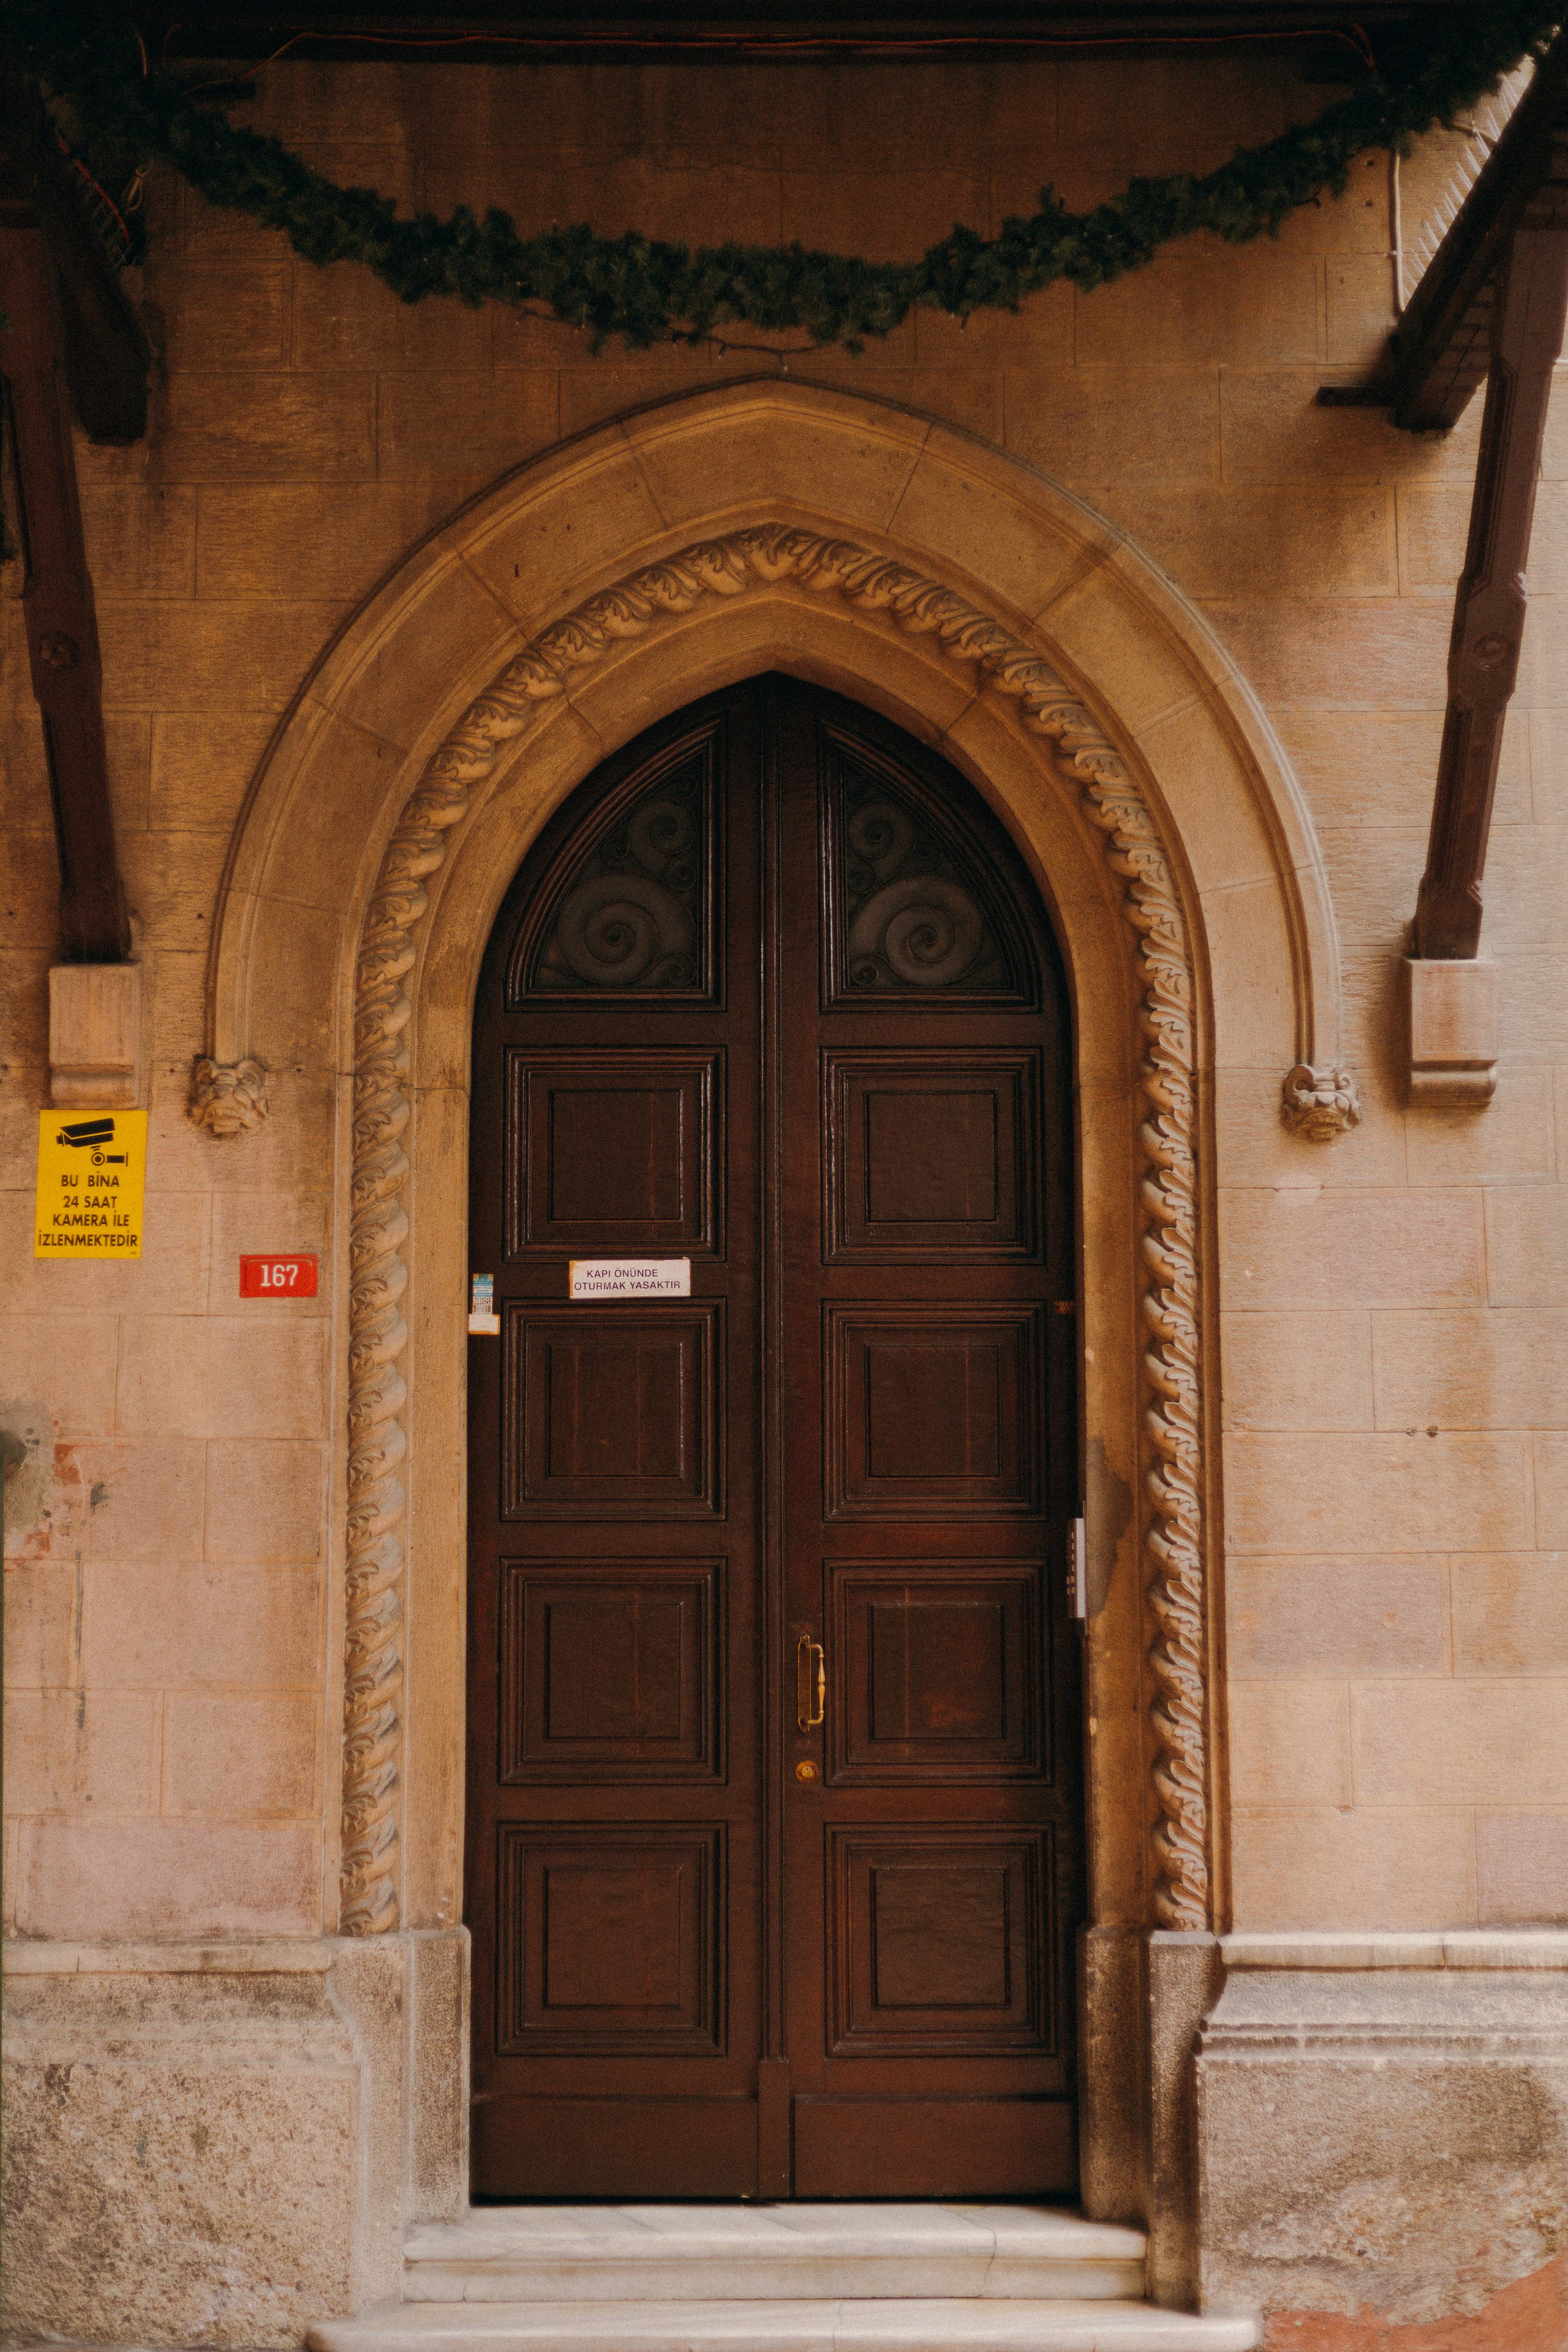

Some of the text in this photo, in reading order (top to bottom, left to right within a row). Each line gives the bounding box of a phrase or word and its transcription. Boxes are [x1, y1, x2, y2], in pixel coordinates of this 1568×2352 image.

[61, 1170, 120, 1187] BU BİNA
[62, 1195, 118, 1208] 24 SAAT
[52, 1210, 129, 1227] KAMERA İLE
[38, 1229, 138, 1247] İZLENMEKTEDİR
[260, 1264, 298, 1287] 167
[614, 1267, 658, 1278] ÖNÜNDE
[574, 1281, 680, 1291] OTURMAK YASAKTIR
